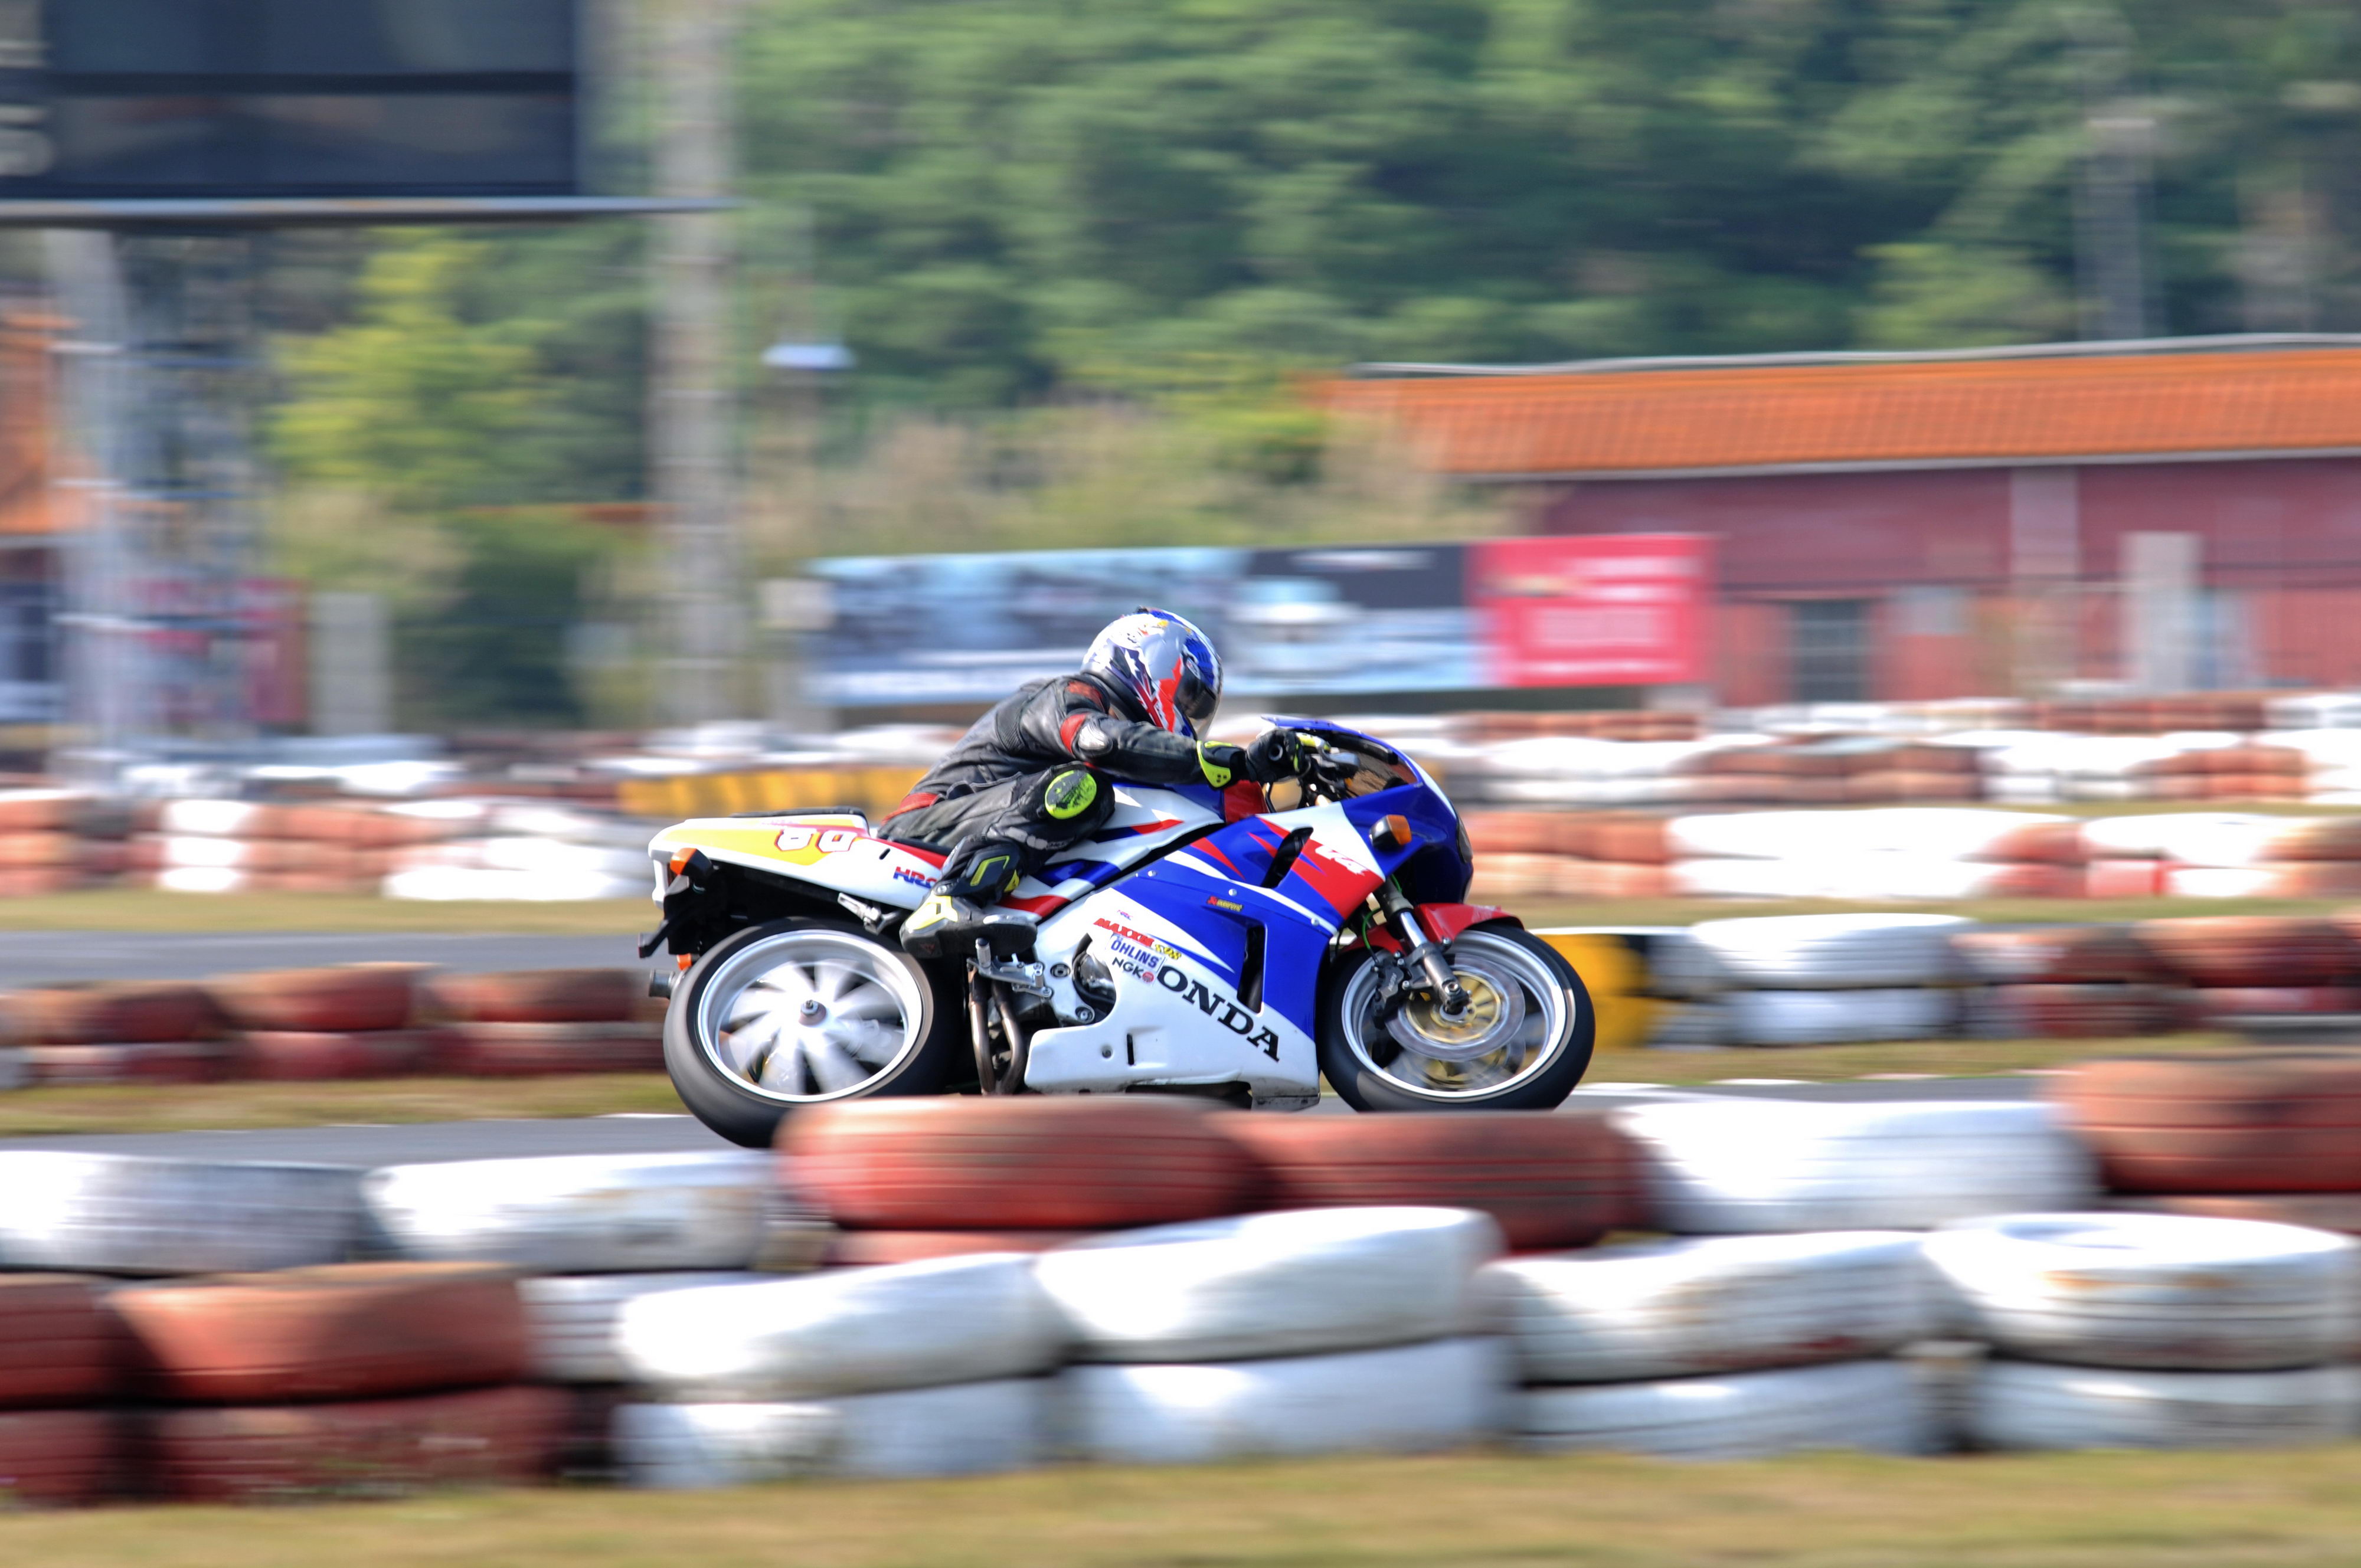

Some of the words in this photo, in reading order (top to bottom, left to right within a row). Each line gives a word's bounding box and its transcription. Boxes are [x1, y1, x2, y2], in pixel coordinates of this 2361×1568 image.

[1110, 934, 1160, 968] ÖHLINS
[1112, 957, 1144, 979] NGK
[1157, 965, 1280, 1063] ONDA
